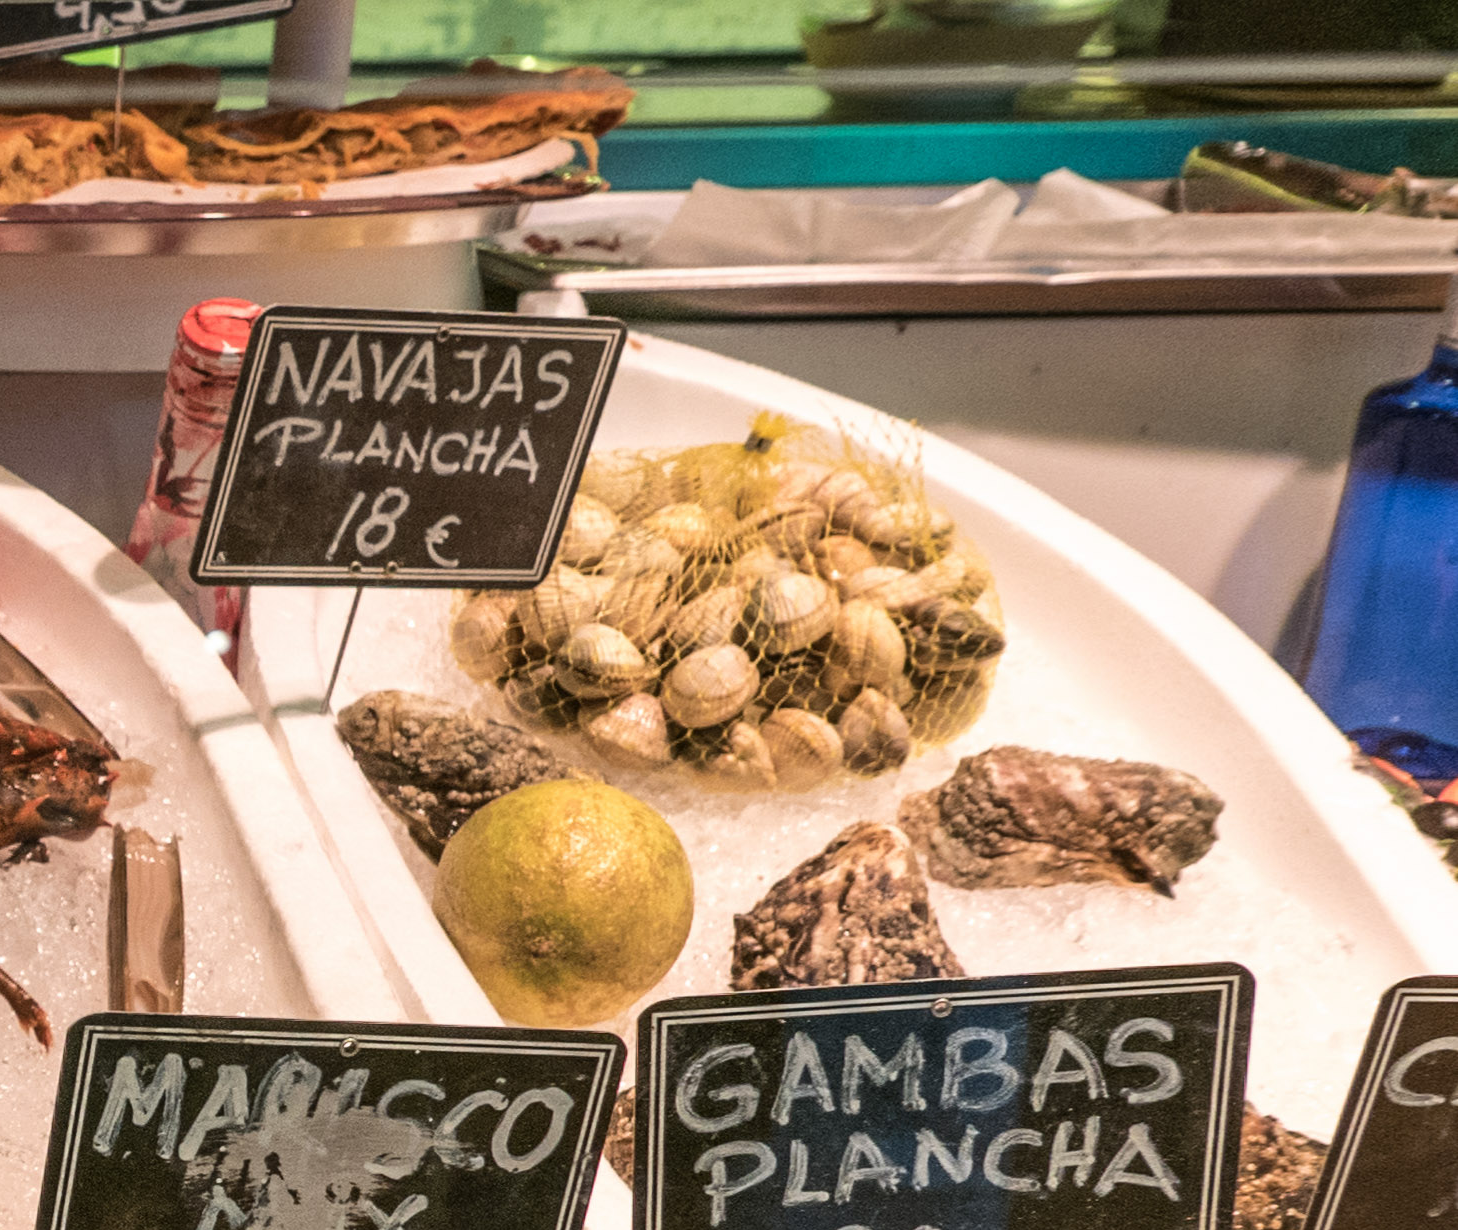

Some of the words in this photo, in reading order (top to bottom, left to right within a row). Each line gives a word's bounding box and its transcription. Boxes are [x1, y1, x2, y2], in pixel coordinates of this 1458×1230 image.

[265, 333, 573, 411] NAVAJAS
[253, 417, 540, 484] PLANCHA
[675, 1017, 1183, 1133] GAMBAS
[694, 1115, 1179, 1226] PLANCHA
